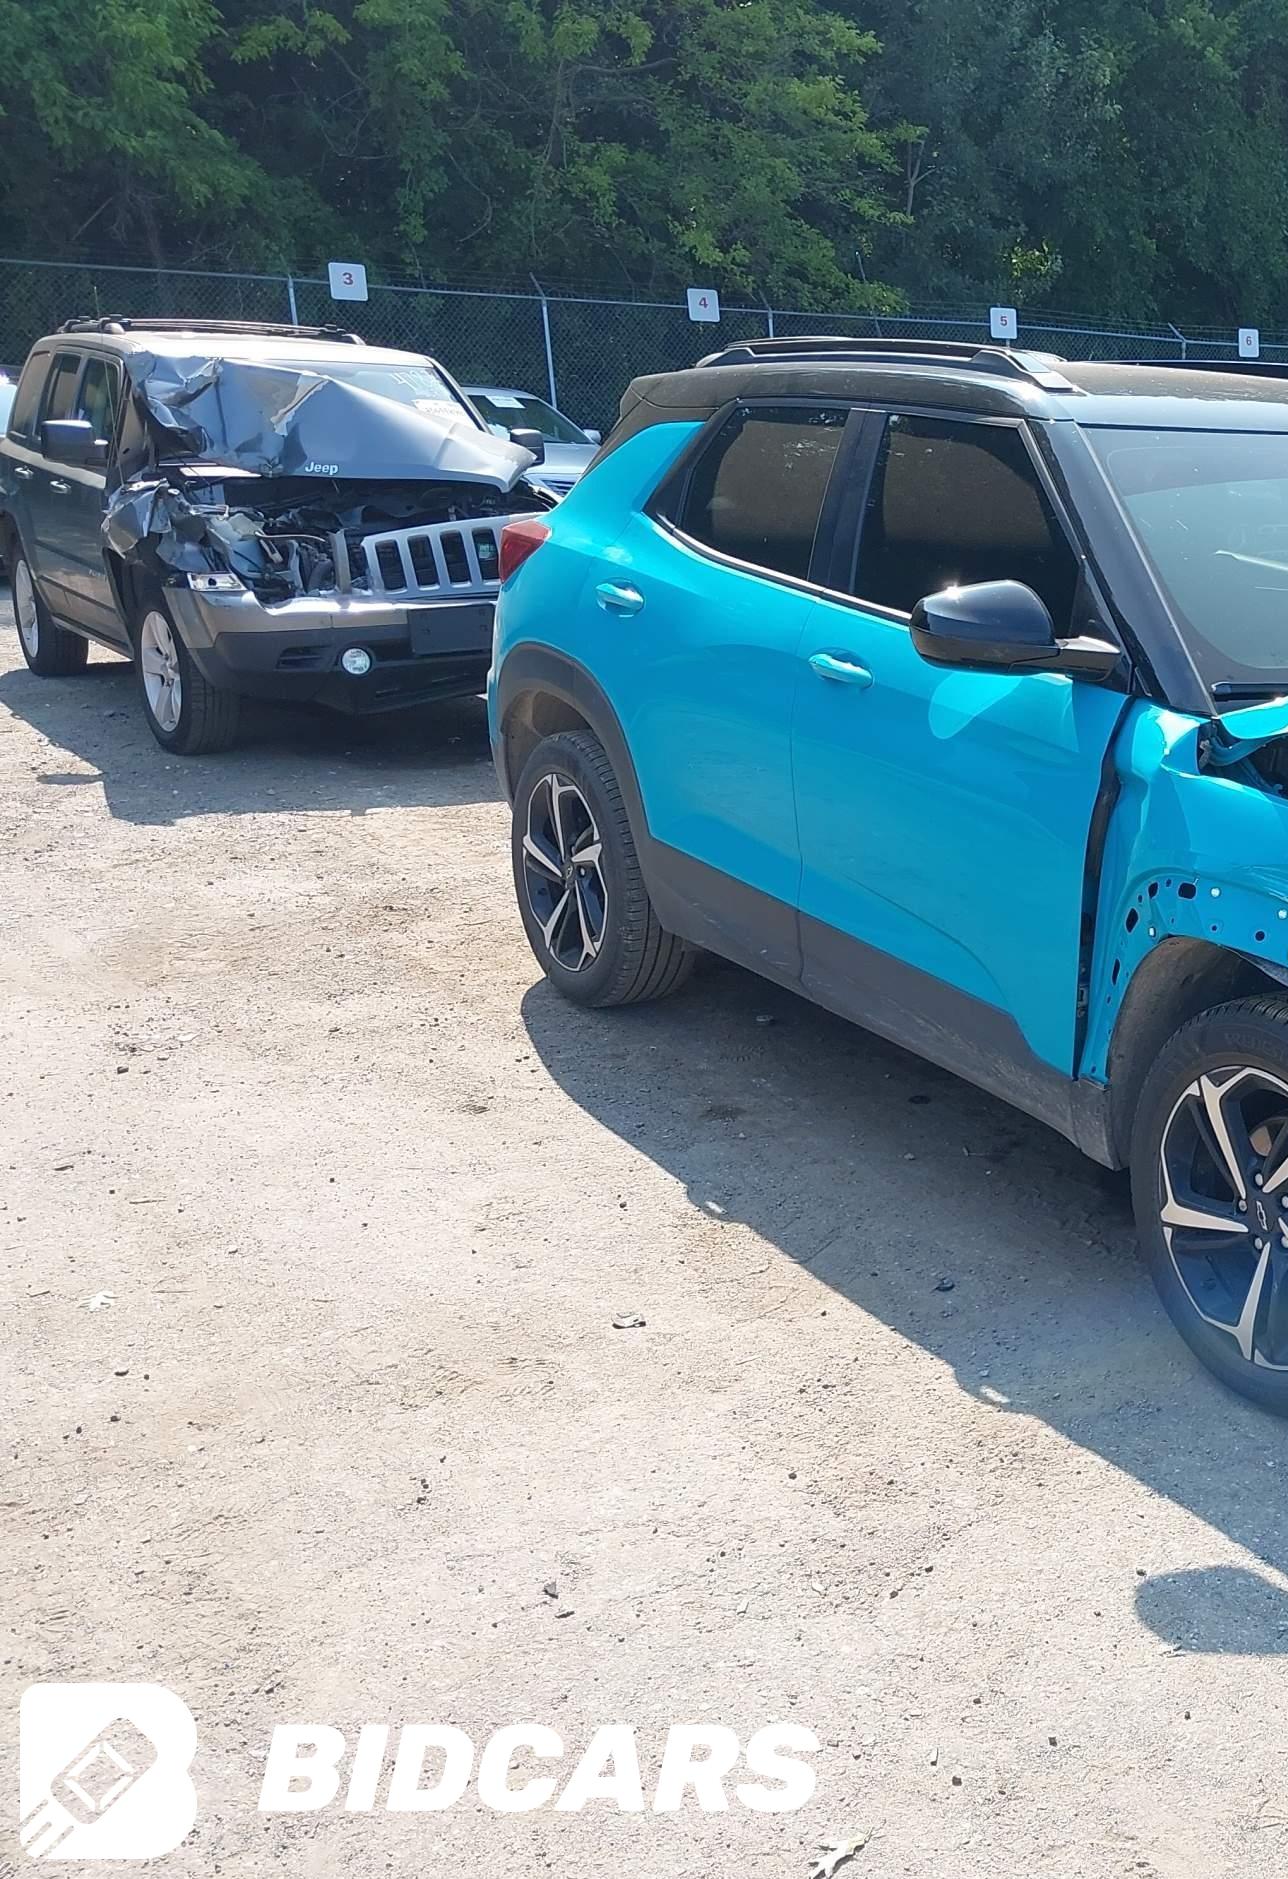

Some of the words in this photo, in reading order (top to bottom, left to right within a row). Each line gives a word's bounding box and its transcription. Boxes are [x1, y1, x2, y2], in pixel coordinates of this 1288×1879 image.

[342, 271, 354, 286] 3
[698, 296, 709, 309] 4
[999, 315, 1008, 327] 5
[1245, 335, 1253, 346] 6
[304, 461, 339, 476] Jeep
